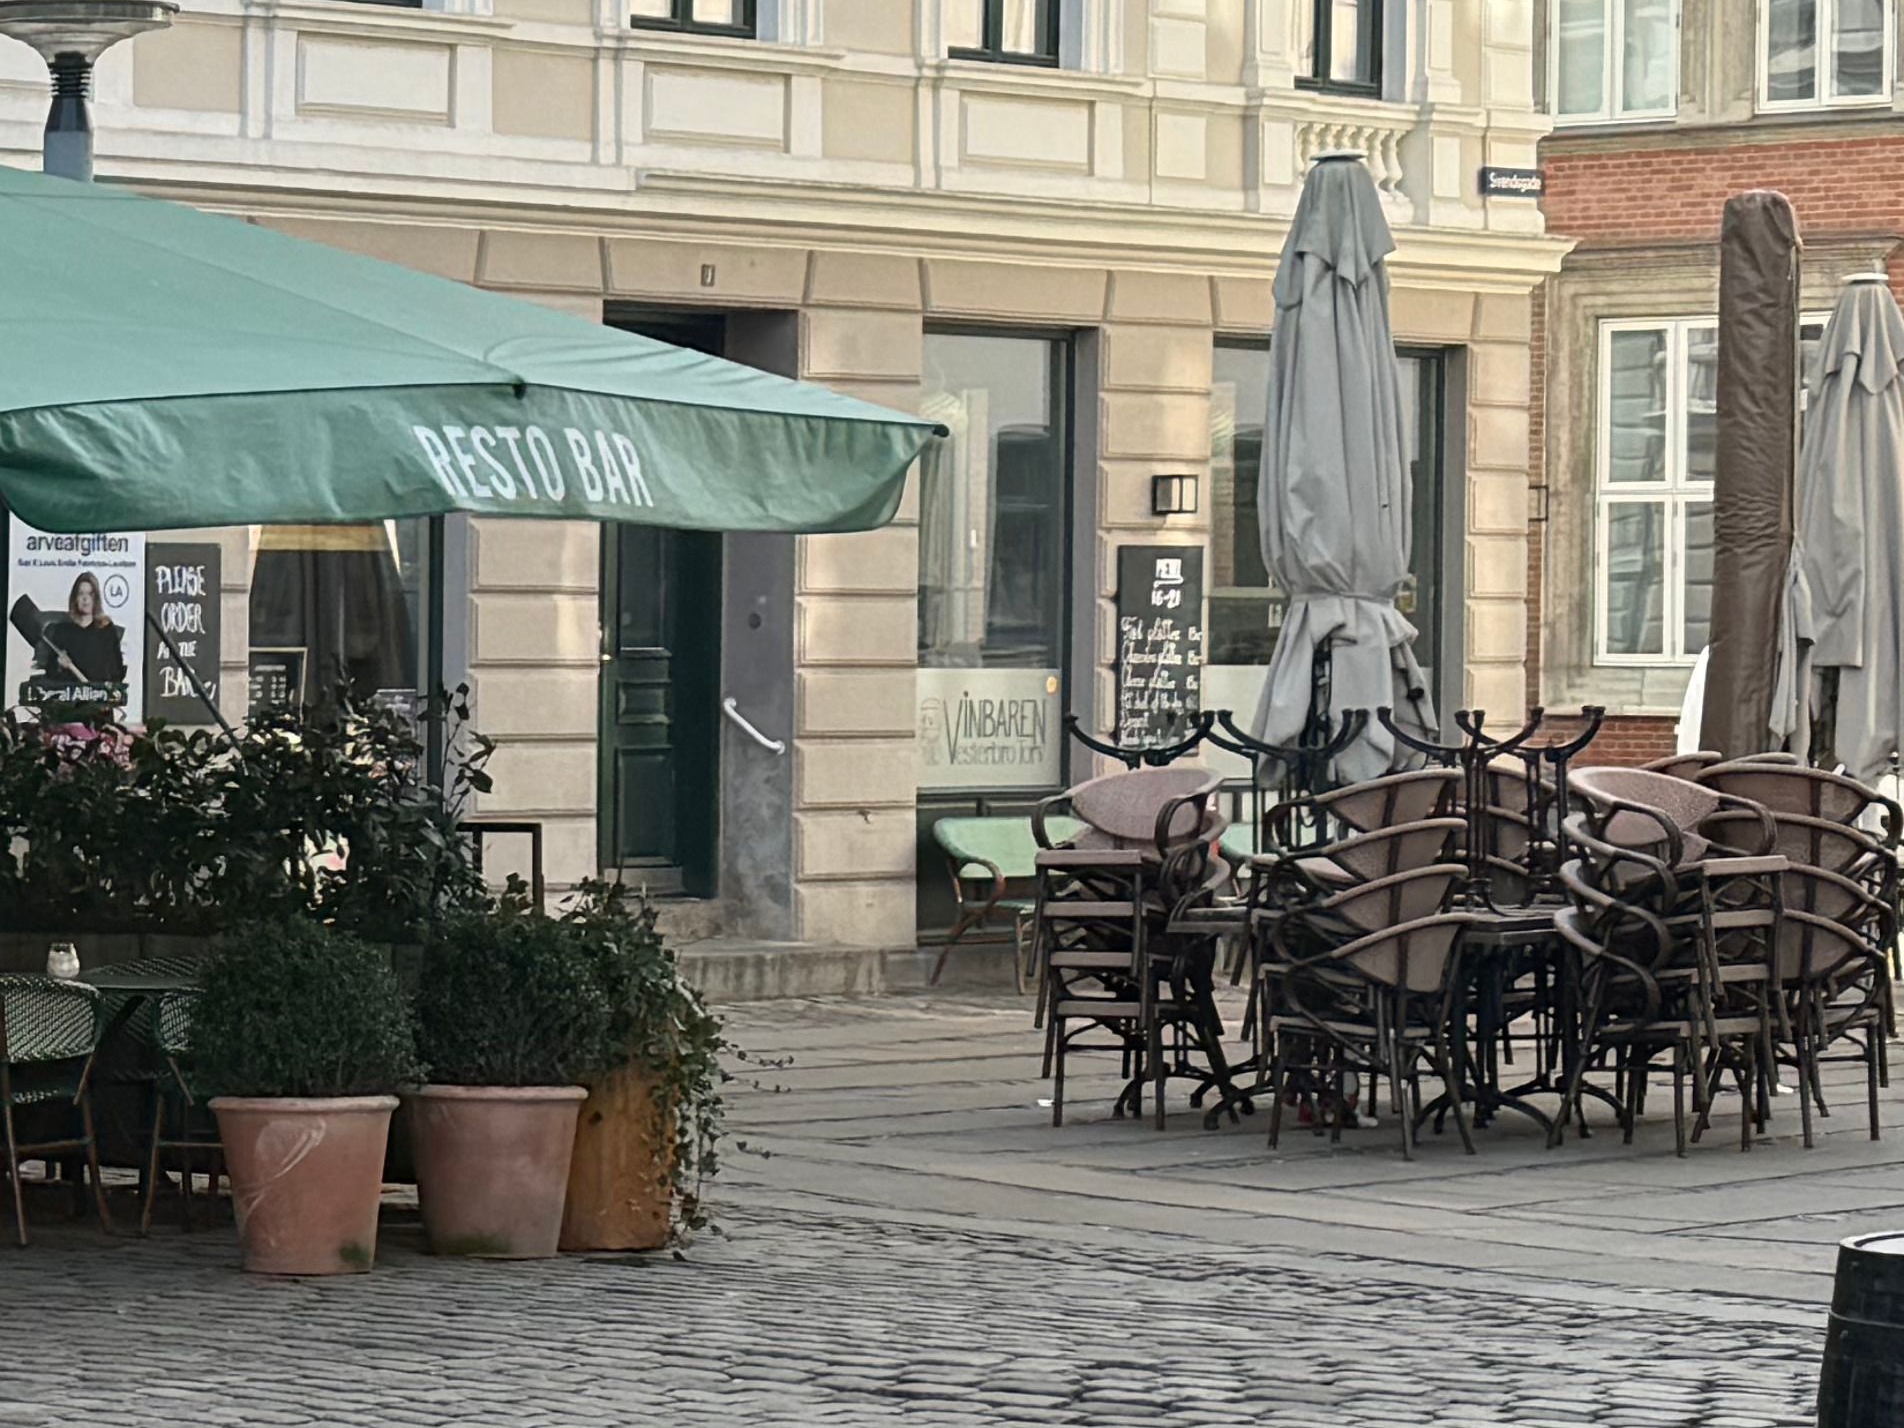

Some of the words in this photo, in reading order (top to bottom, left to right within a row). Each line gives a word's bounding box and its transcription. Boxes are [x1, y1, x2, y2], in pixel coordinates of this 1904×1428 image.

[412, 425, 566, 502] RESTO
[563, 427, 655, 508] BAR
[26, 534, 129, 557] arveafgiften
[109, 585, 123, 598] LA
[155, 565, 206, 597] PLEASE
[161, 601, 206, 634] ORDER
[72, 686, 121, 702] Allian
